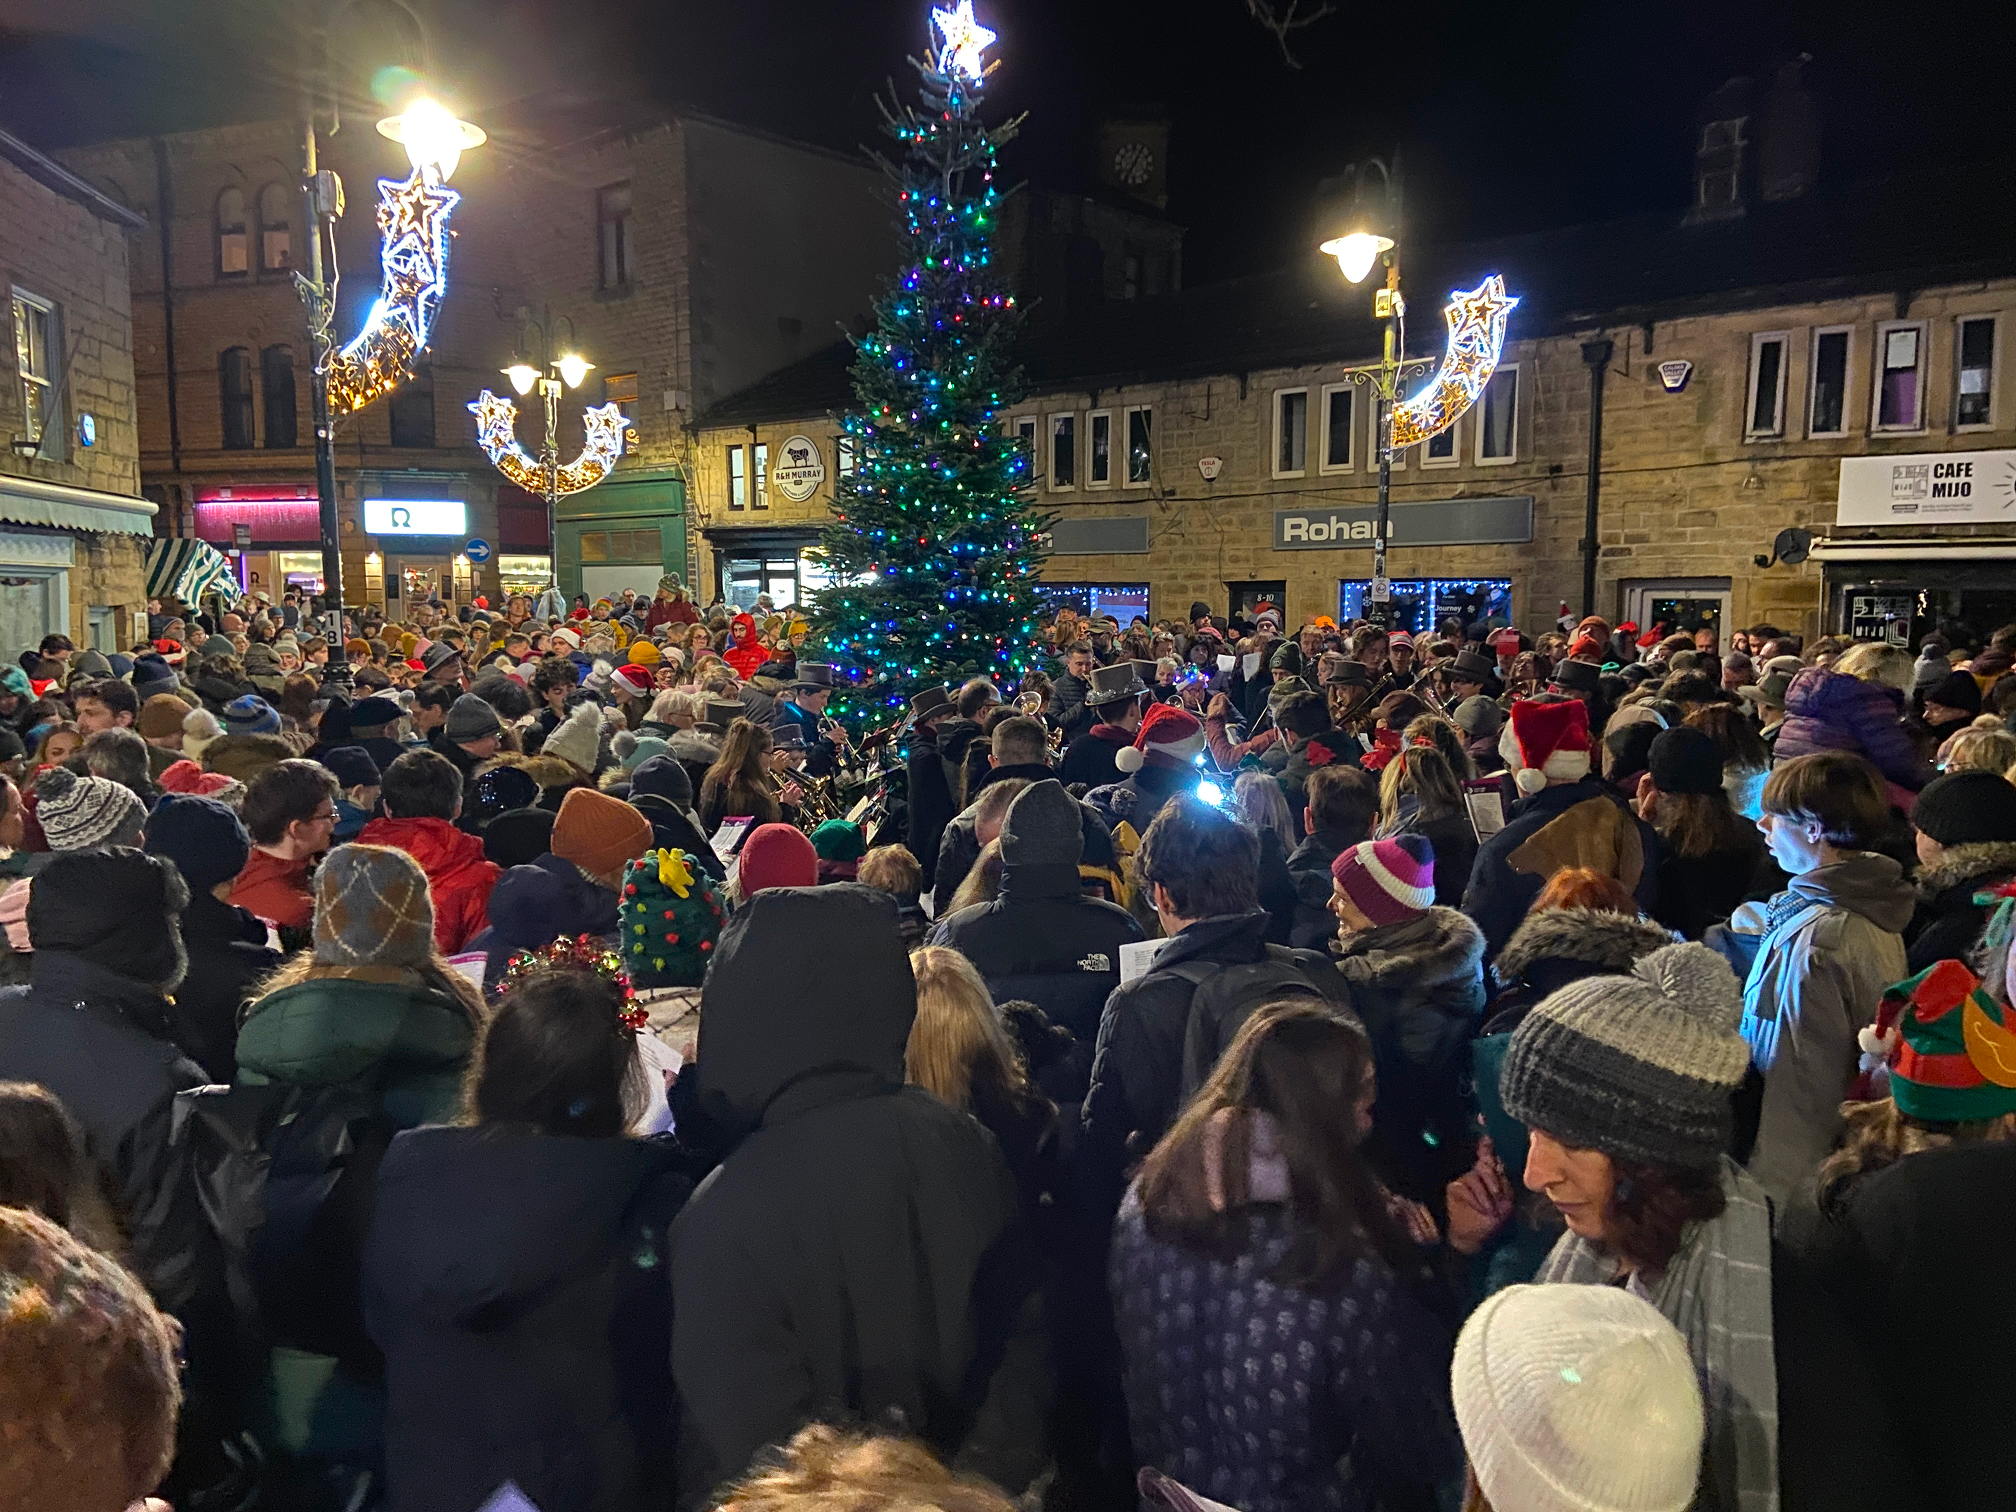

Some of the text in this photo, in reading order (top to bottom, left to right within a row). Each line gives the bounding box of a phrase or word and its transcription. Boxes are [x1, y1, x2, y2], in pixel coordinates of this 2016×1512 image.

[775, 469, 821, 481] R&H MURRAY
[1933, 462, 1974, 478] CAFE
[1932, 482, 1971, 498] MIJO
[1283, 515, 1394, 542] Rohan
[1257, 593, 1275, 602] 8-10
[1435, 604, 1462, 614] Journey
[1855, 625, 1885, 638] MIJO
